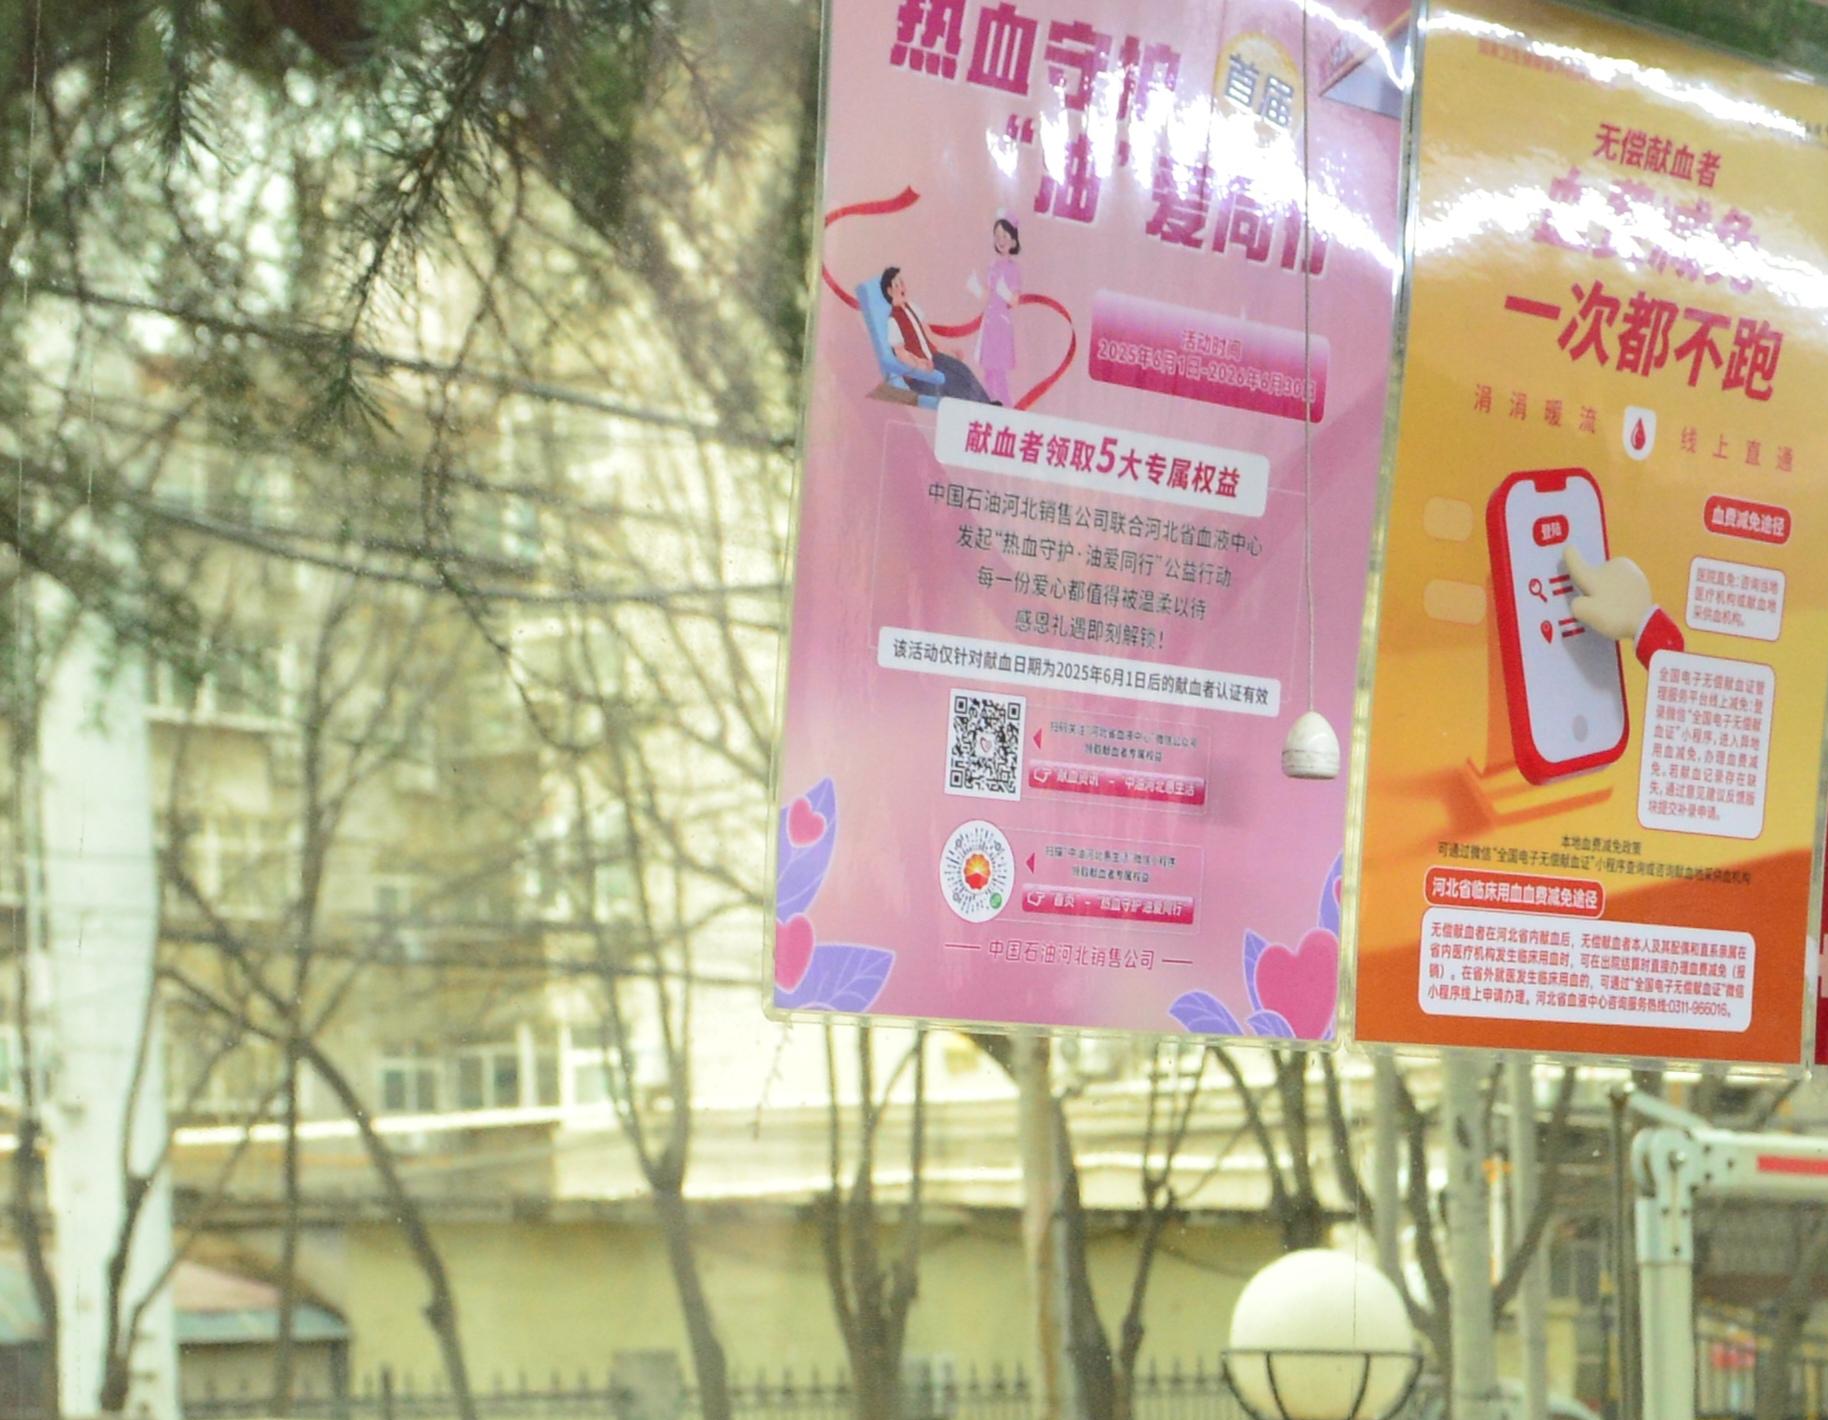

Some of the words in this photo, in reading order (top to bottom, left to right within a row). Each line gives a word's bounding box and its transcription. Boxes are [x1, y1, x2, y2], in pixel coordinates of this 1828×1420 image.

[1592, 122, 1722, 189] 无偿献血者
[1098, 337, 1318, 402] 2025年6月1日-2026年6月30日
[1183, 328, 1242, 361] 活动时间
[1503, 279, 1784, 403] 一次都不跑
[1473, 383, 1600, 436] 涓涓暖流
[965, 420, 1241, 499] 献血者领取5大专属权益
[928, 483, 1263, 558] 中国石油河北销售公司联合河北省血液中心
[1711, 505, 1786, 538] 血费减免途径
[976, 566, 1207, 621] 每一份爱心都值得被温柔以待
[892, 637, 1270, 707] 该活动仅针对献血日期为2025年6月1日后的献血者认证有效
[1431, 875, 1599, 911] 河北省临床用血血费减免途径
[989, 940, 1155, 971] 中国石油河北销售公司
